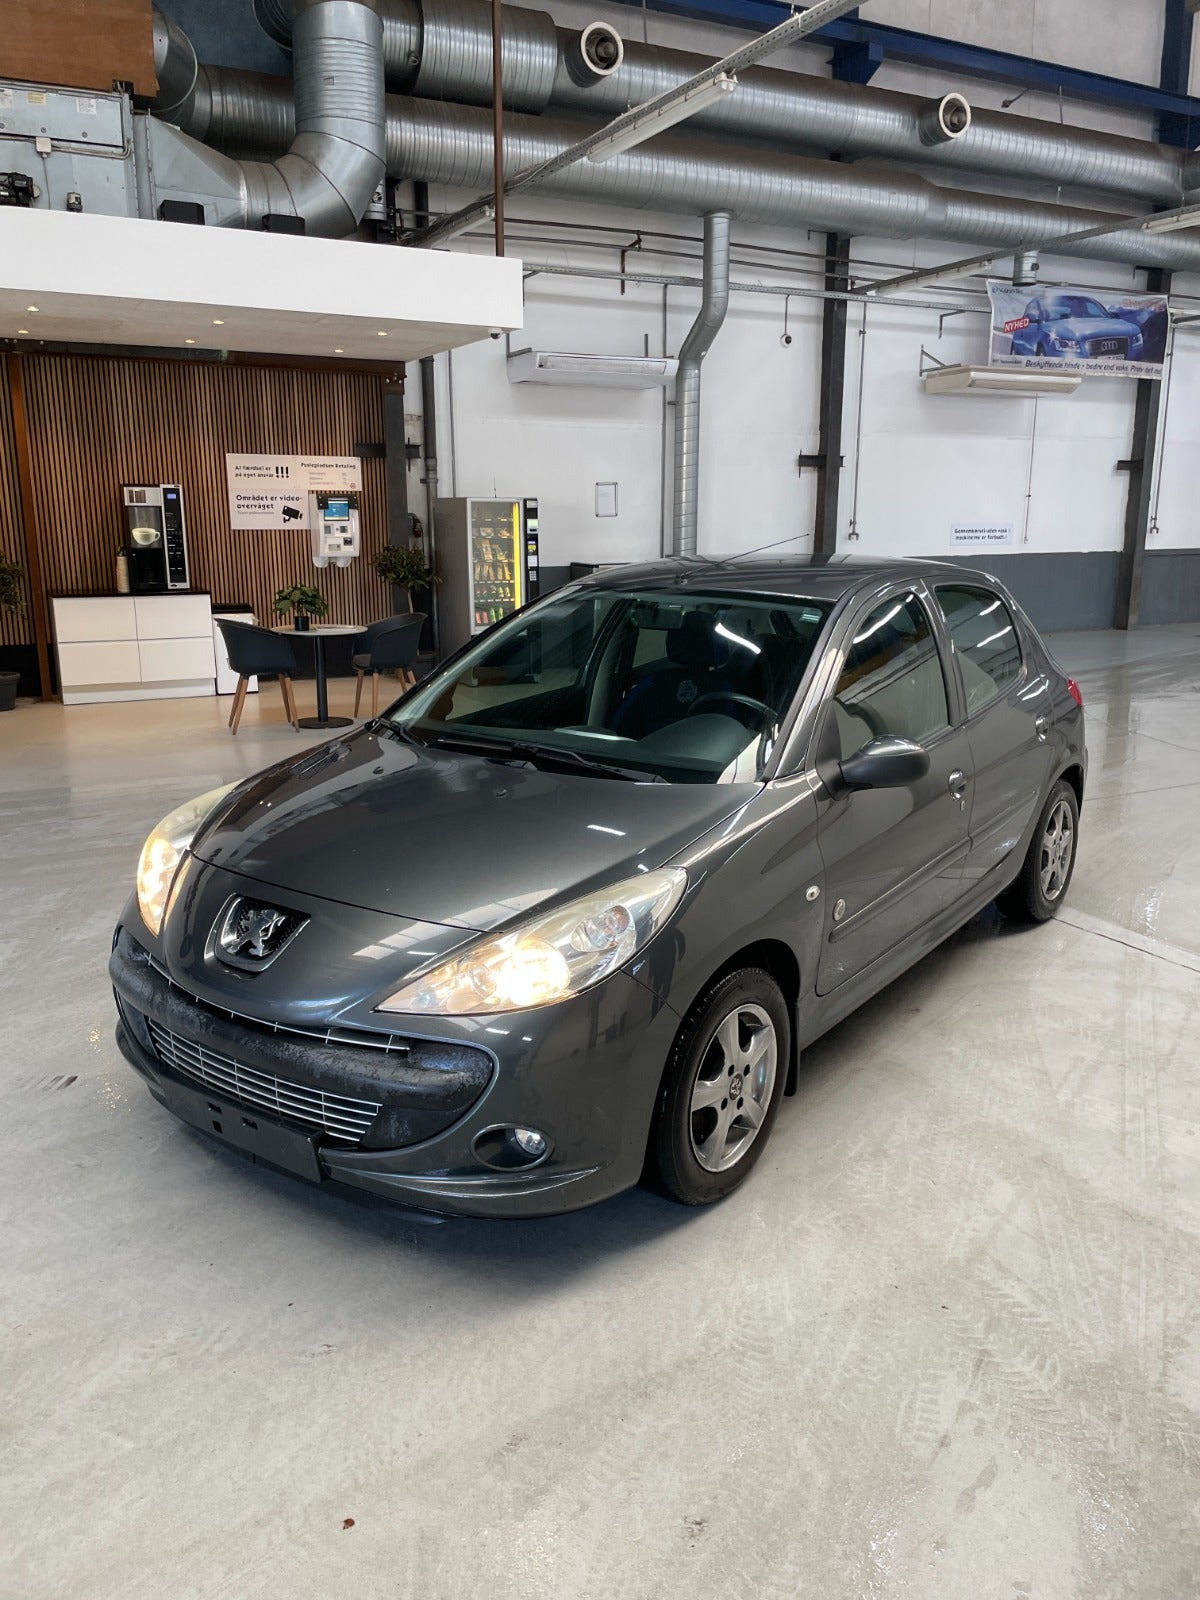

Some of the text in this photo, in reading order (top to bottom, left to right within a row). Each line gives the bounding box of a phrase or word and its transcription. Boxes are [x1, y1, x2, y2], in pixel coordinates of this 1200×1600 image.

[1004, 318, 1029, 332] NYHED
[1025, 360, 1063, 369] Beskyttende
[1063, 361, 1080, 370] hinde
[236, 502, 274, 510] overvåget
